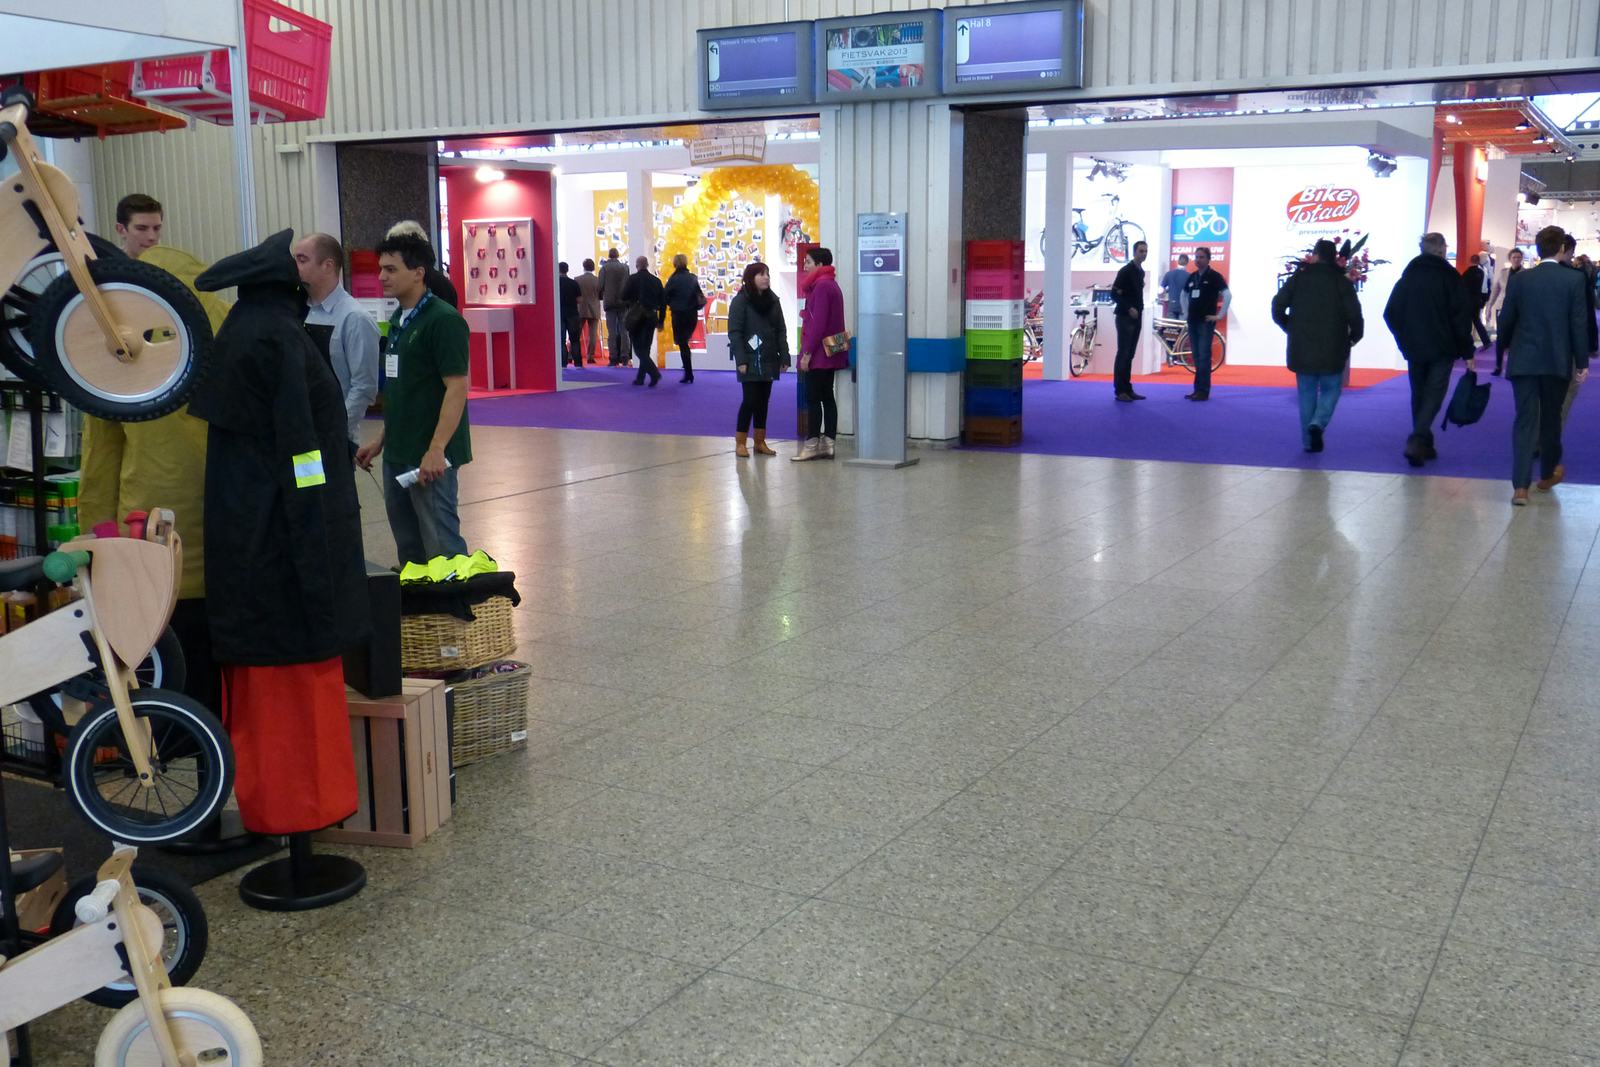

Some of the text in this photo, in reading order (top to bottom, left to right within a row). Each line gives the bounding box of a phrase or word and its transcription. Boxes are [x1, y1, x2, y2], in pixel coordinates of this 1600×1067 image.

[970, 17, 992, 28] Hal 8
[841, 47, 908, 59] FIETSVAK 2013
[1298, 184, 1353, 203] Bike
[1286, 195, 1359, 230] Totaal
[1298, 228, 1340, 236] presenteert
